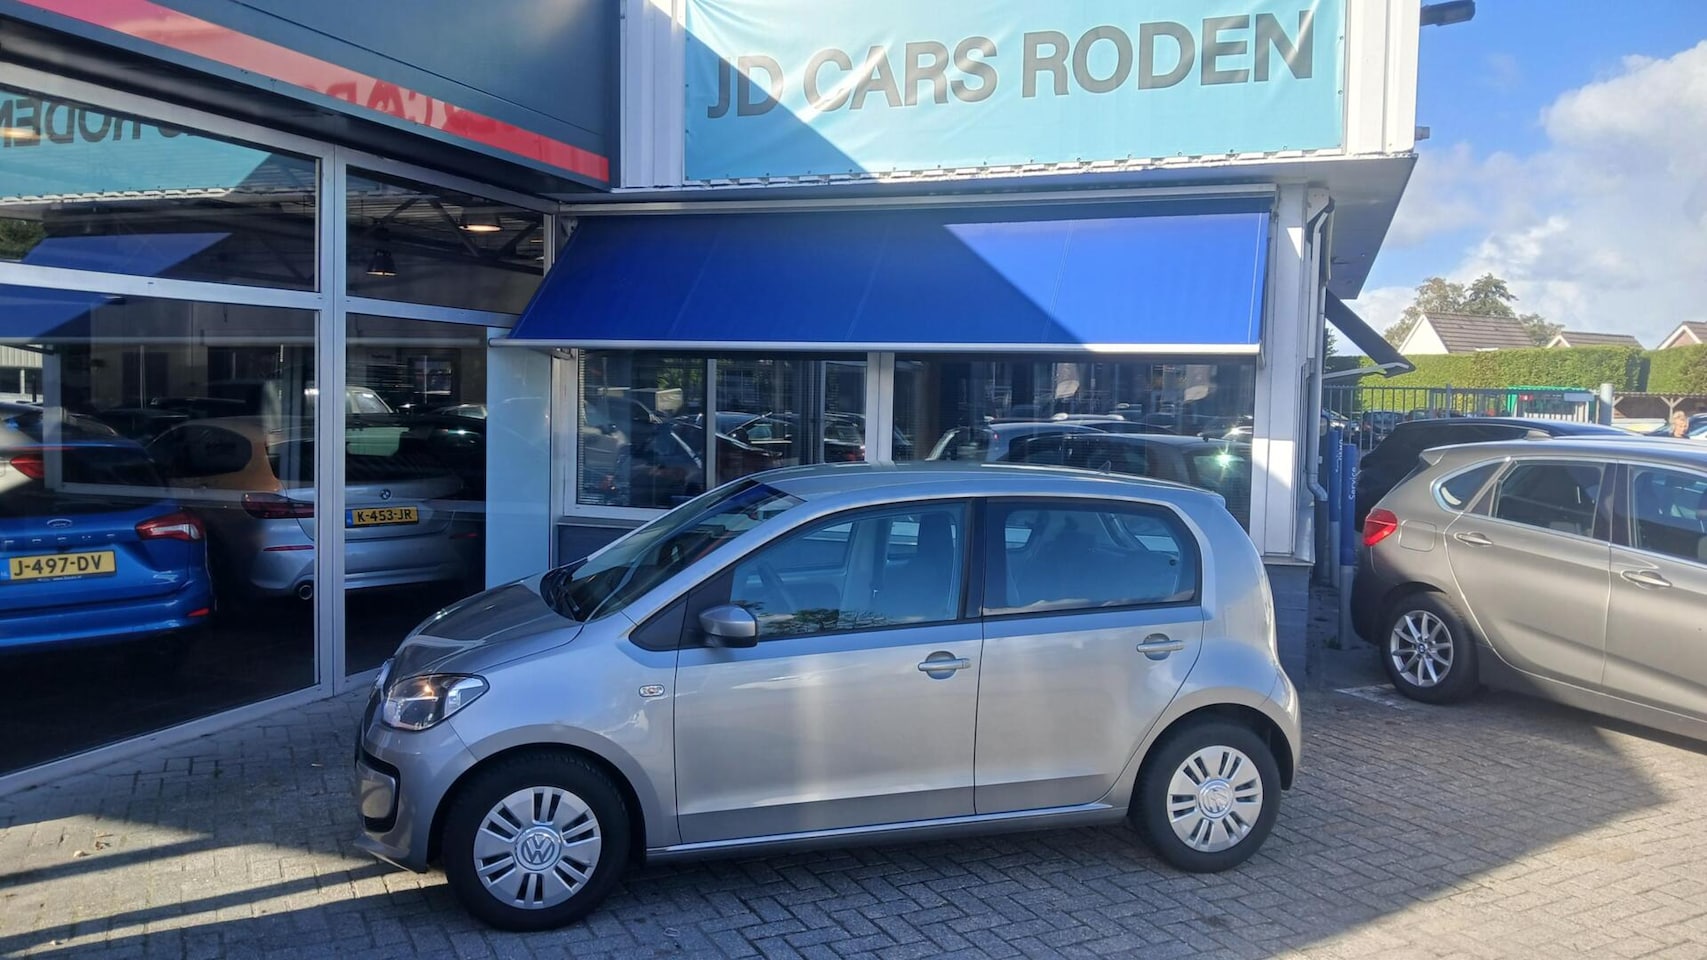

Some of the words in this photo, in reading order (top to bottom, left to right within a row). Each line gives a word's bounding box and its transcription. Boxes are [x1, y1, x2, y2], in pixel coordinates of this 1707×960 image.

[707, 54, 784, 119] JD
[803, 36, 998, 112] CARS
[1022, 9, 1315, 98] RODEN
[1348, 466, 1357, 500] Service
[357, 509, 412, 523] K-453-JR
[13, 554, 102, 577] J-497-DV
